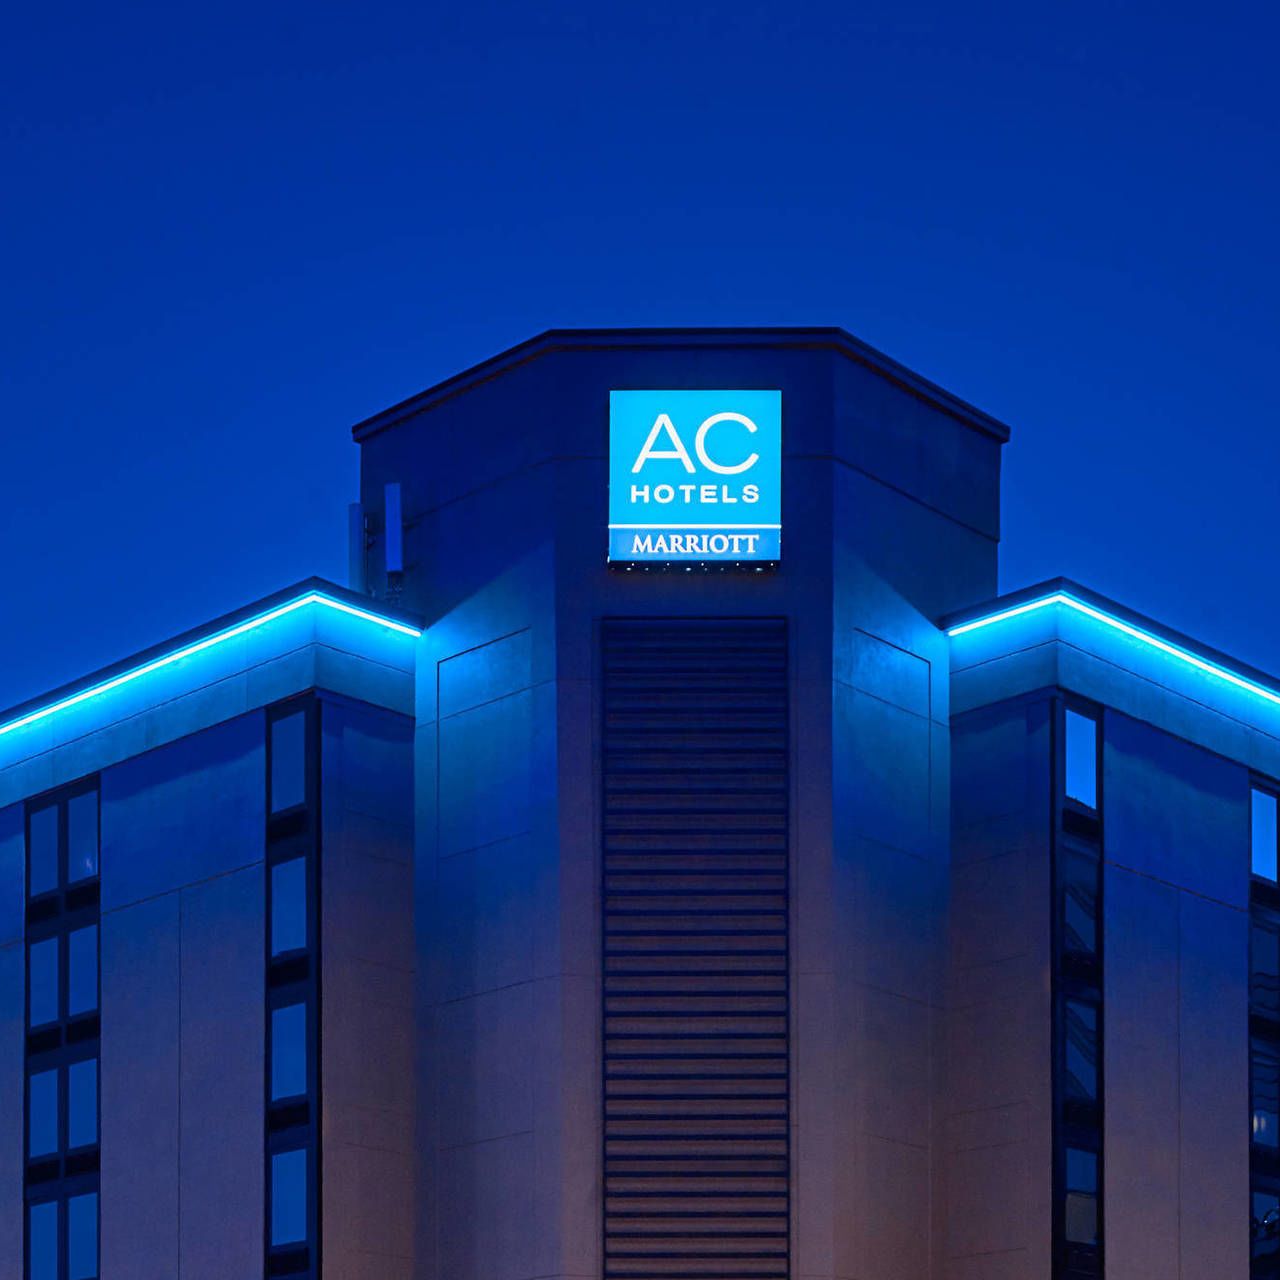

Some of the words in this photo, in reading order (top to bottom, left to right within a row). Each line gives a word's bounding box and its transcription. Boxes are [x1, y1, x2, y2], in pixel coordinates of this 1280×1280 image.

[631, 412, 759, 474] AC
[631, 484, 759, 503] HOTELS
[631, 534, 759, 553] MARRIOTT
